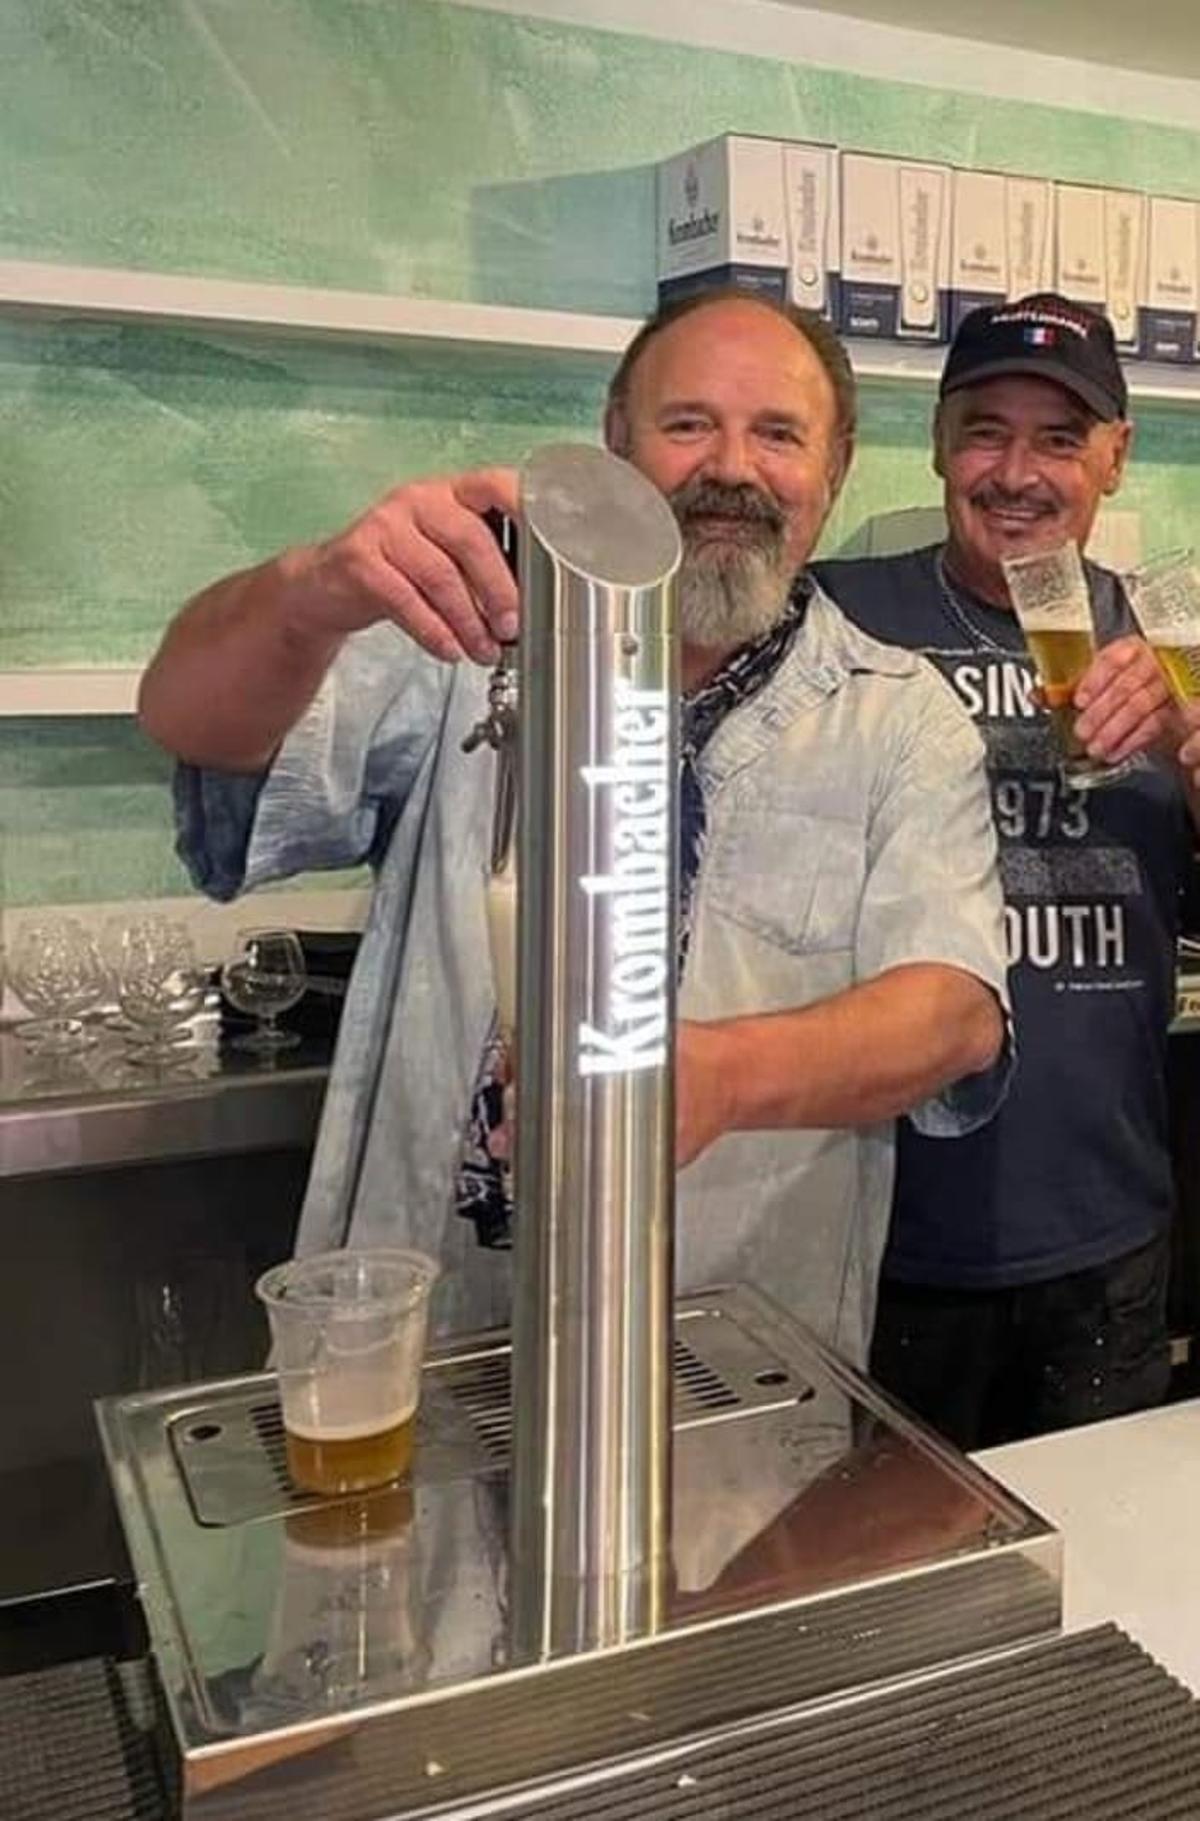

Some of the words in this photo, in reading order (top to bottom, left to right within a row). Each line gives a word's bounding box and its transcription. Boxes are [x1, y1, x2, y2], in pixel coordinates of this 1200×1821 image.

[997, 780, 1089, 838] 973
[578, 677, 669, 1076] Krombacher
[1003, 904, 1125, 967] OUTH
